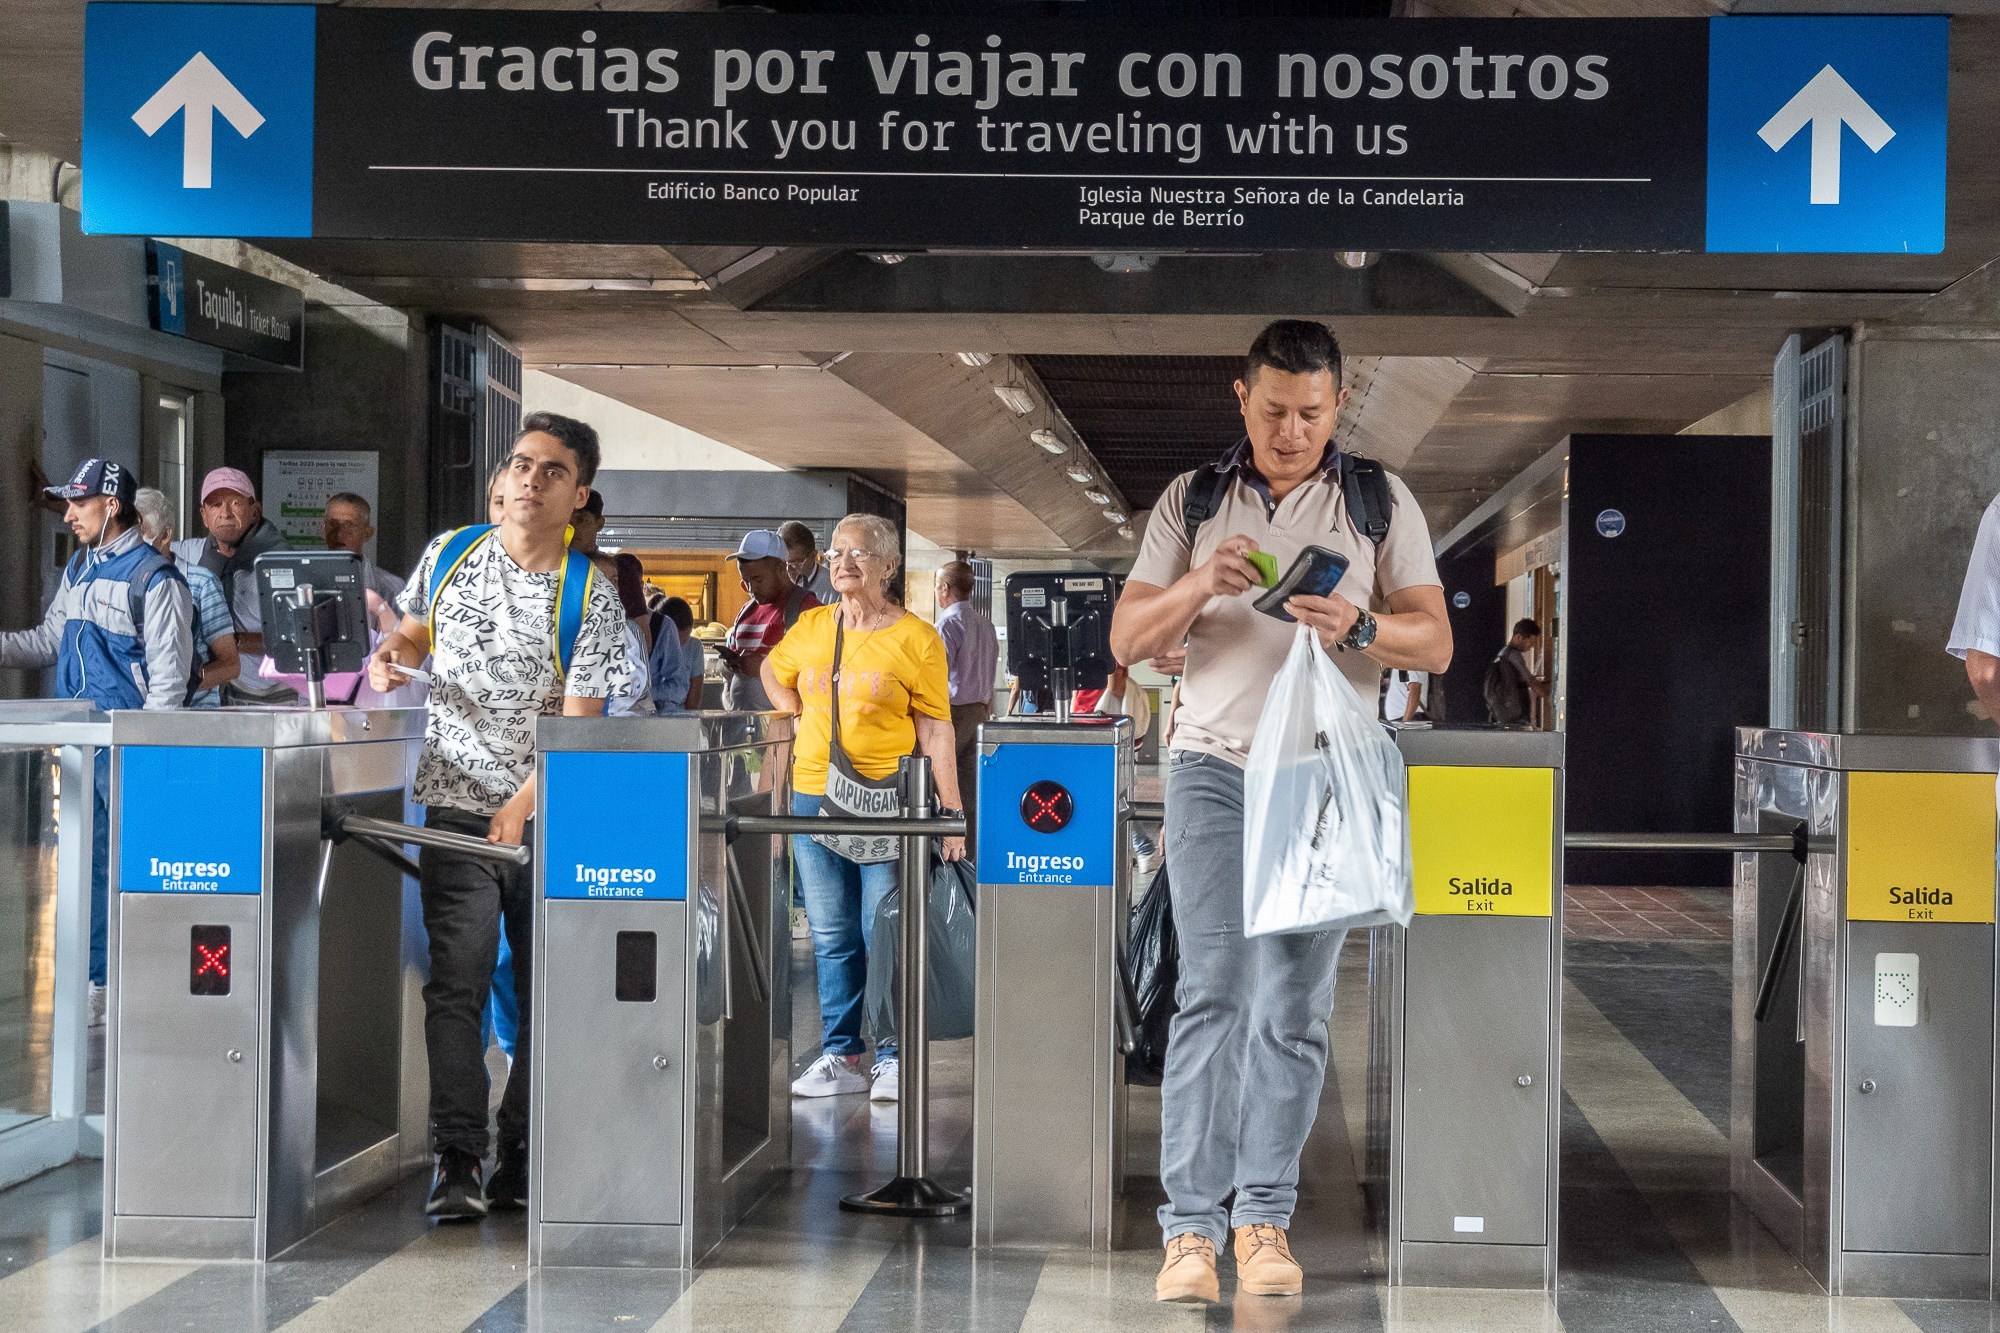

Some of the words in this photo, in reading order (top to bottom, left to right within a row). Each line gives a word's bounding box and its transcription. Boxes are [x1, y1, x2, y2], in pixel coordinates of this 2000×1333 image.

[412, 30, 680, 93] Gracias
[713, 48, 835, 107] por
[866, 34, 1086, 110] viajar
[1118, 52, 1242, 98] con
[1278, 46, 1610, 100] nosotros
[607, 108, 749, 149] Thank
[771, 118, 856, 159] you
[879, 110, 955, 152] for
[976, 111, 1202, 163] traveling
[1226, 112, 1333, 154] with
[1355, 122, 1409, 155] us
[647, 182, 716, 200] Edificio
[724, 184, 780, 201] Banco
[787, 184, 860, 204] Popular
[1079, 187, 1142, 207] Iglesia
[1150, 187, 1225, 205] Nuestra
[1234, 187, 1300, 205] Señora
[1308, 189, 1330, 205] de
[1338, 189, 1355, 205] la
[1363, 189, 1465, 206] Candelaria
[1079, 209, 1145, 229] Parque
[1152, 210, 1175, 226] de
[1183, 209, 1245, 227] Berrío
[196, 279, 243, 330] Taquilla
[250, 309, 270, 336] Ticket
[271, 316, 291, 342] Booth
[102, 462, 120, 496] EXC
[150, 858, 231, 879] Ingreso
[1006, 850, 1085, 874] Ingreso
[162, 878, 218, 892] Entrance
[575, 865, 657, 886] Ingreso
[1018, 871, 1072, 885] Entrance
[588, 884, 644, 898] Entrance
[1448, 877, 1513, 896] Salida
[1889, 886, 1953, 906] Salida
[1467, 899, 1494, 911] Exit
[1908, 908, 1934, 919] Exit
